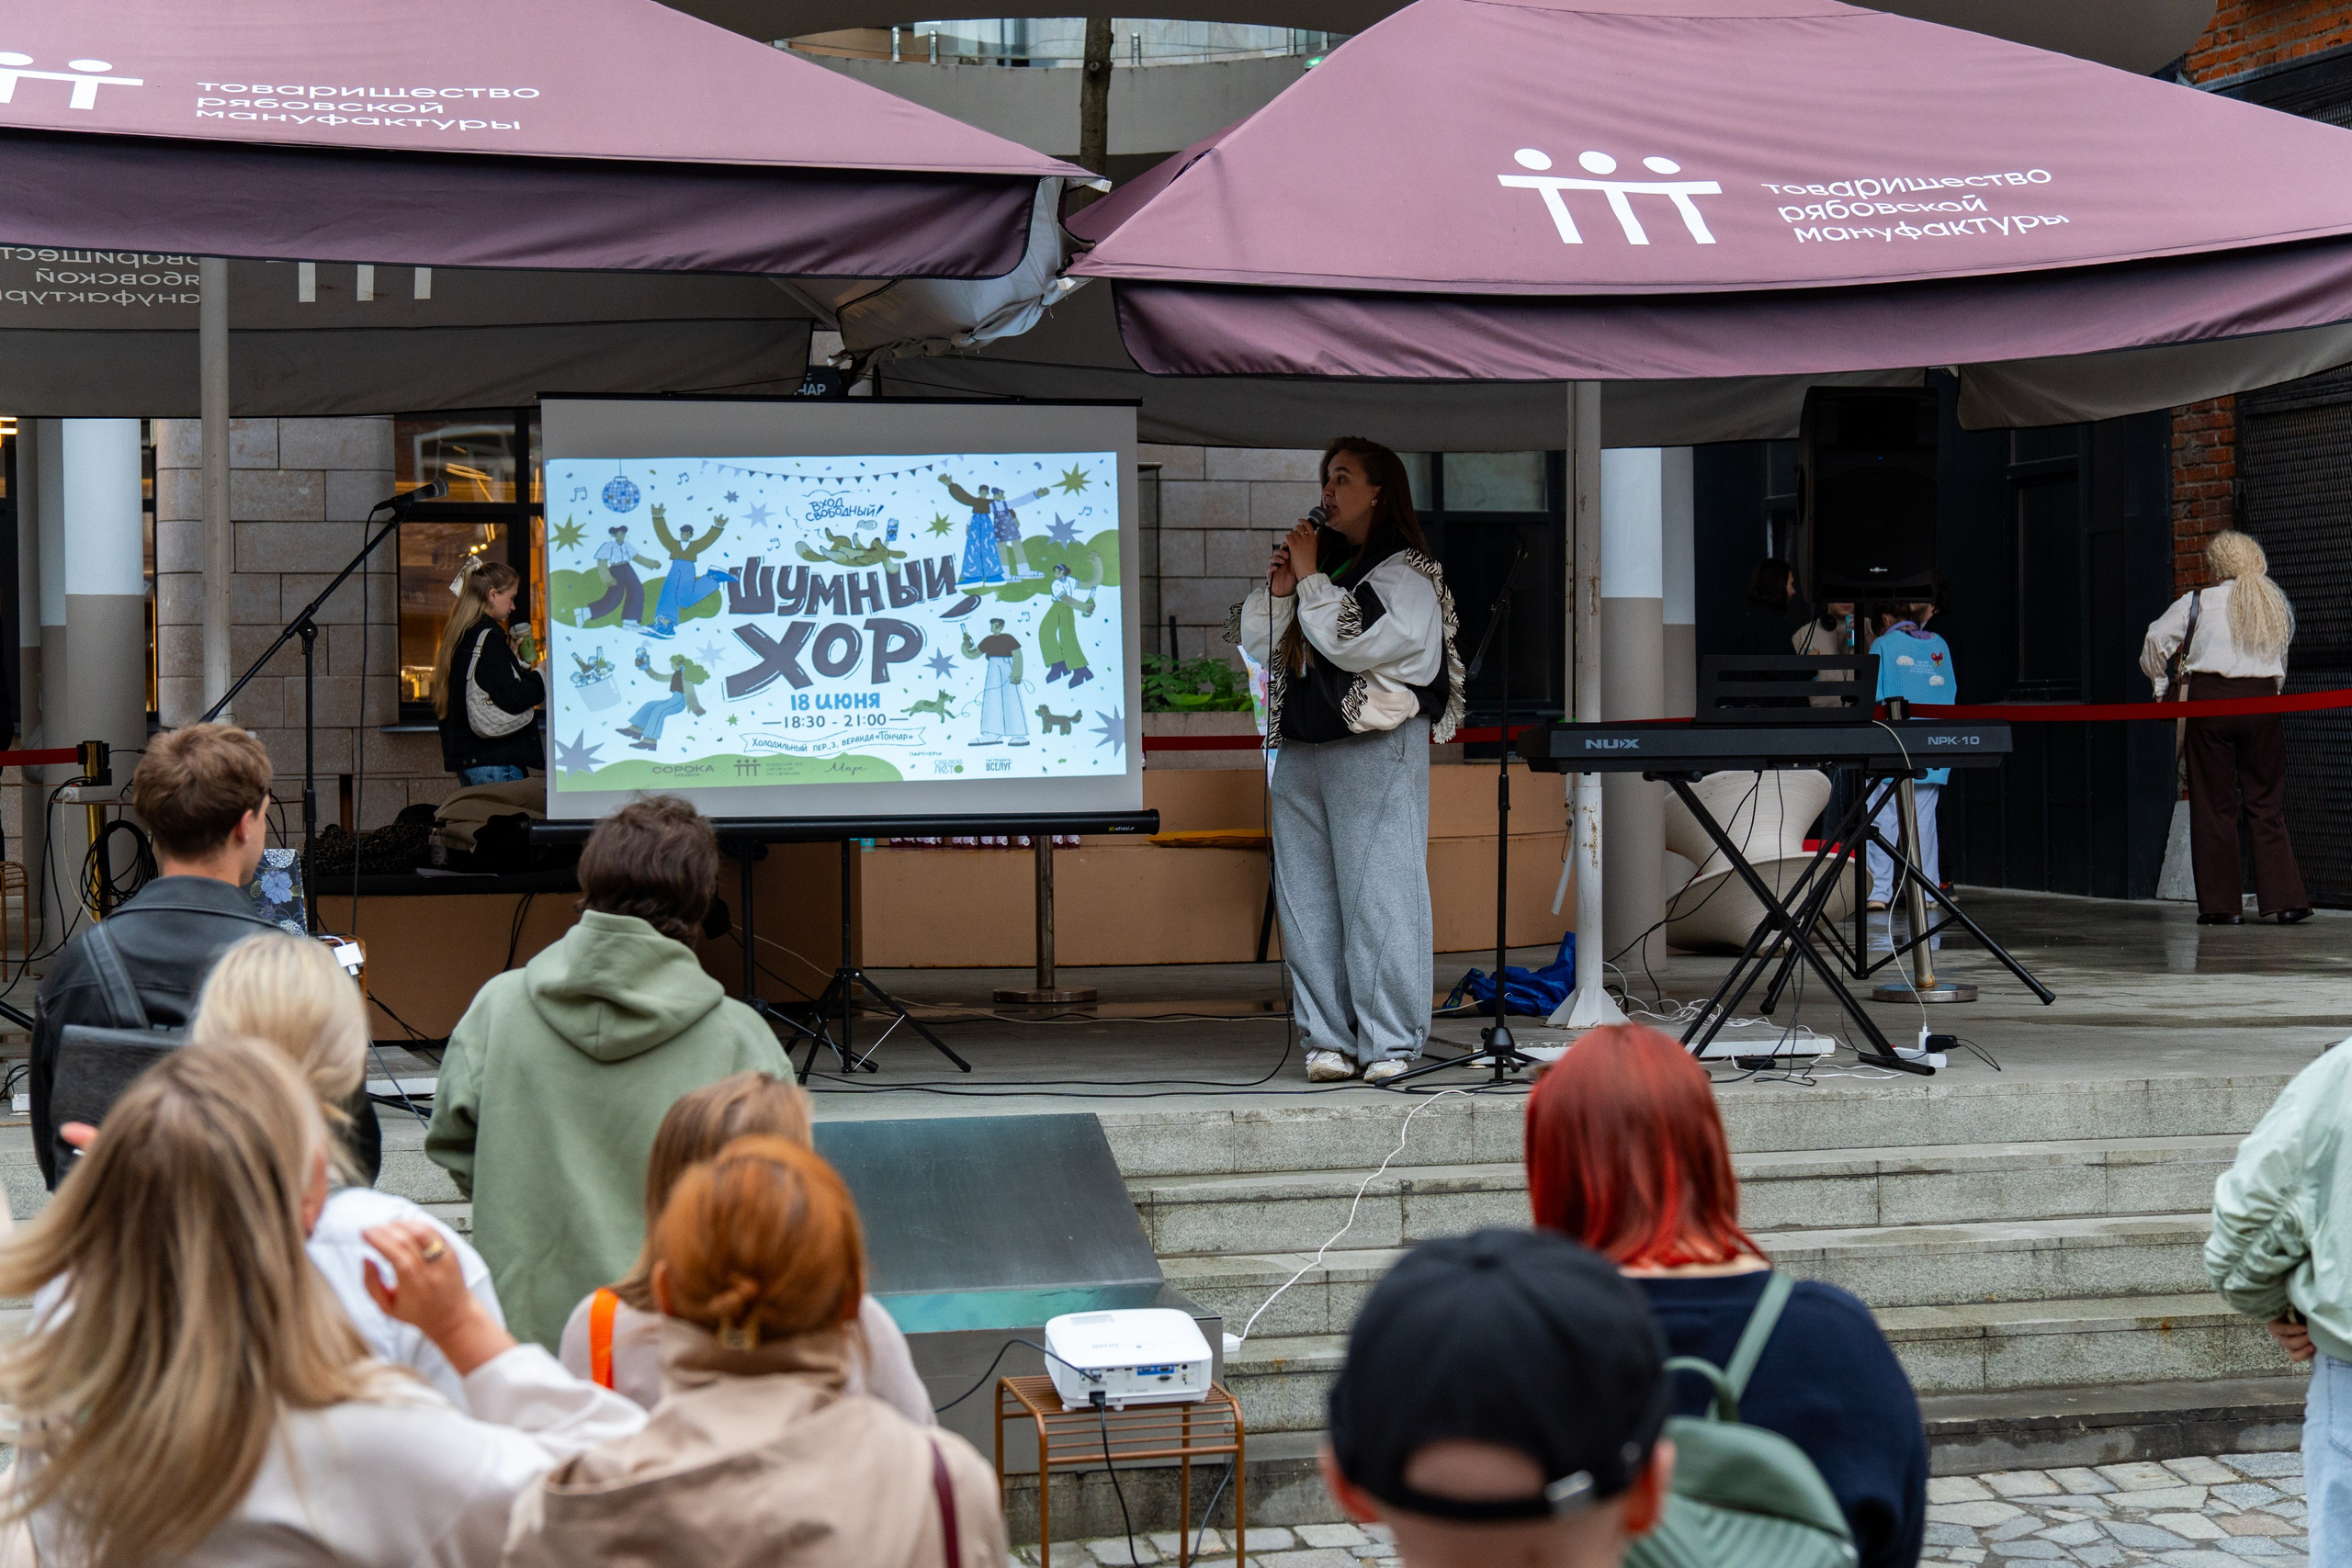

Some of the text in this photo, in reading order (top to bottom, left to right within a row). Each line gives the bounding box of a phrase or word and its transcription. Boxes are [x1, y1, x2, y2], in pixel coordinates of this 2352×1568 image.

[197, 82, 540, 99] товарищество
[197, 96, 444, 114] рябовской
[196, 109, 521, 131] мануфактуры
[1760, 168, 2052, 200] товарищество
[1778, 194, 1989, 223] рябовской
[1793, 214, 2070, 243] мануфактуры
[805, 504, 884, 522] СВОБОДНЫЙ!
[808, 497, 844, 512] ВХОД
[727, 555, 957, 616] ШУМНЫЙ
[725, 617, 924, 699] ХОР
[790, 693, 881, 711] 18 ИЮНЯ
[784, 716, 826, 728] 18:30
[843, 714, 887, 727] 21:00
[1585, 739, 1640, 750] NUX
[1928, 736, 1981, 746] NPK-10
[651, 764, 716, 774] СОРОКА
[986, 761, 1012, 772] ВСЕЛУГ
